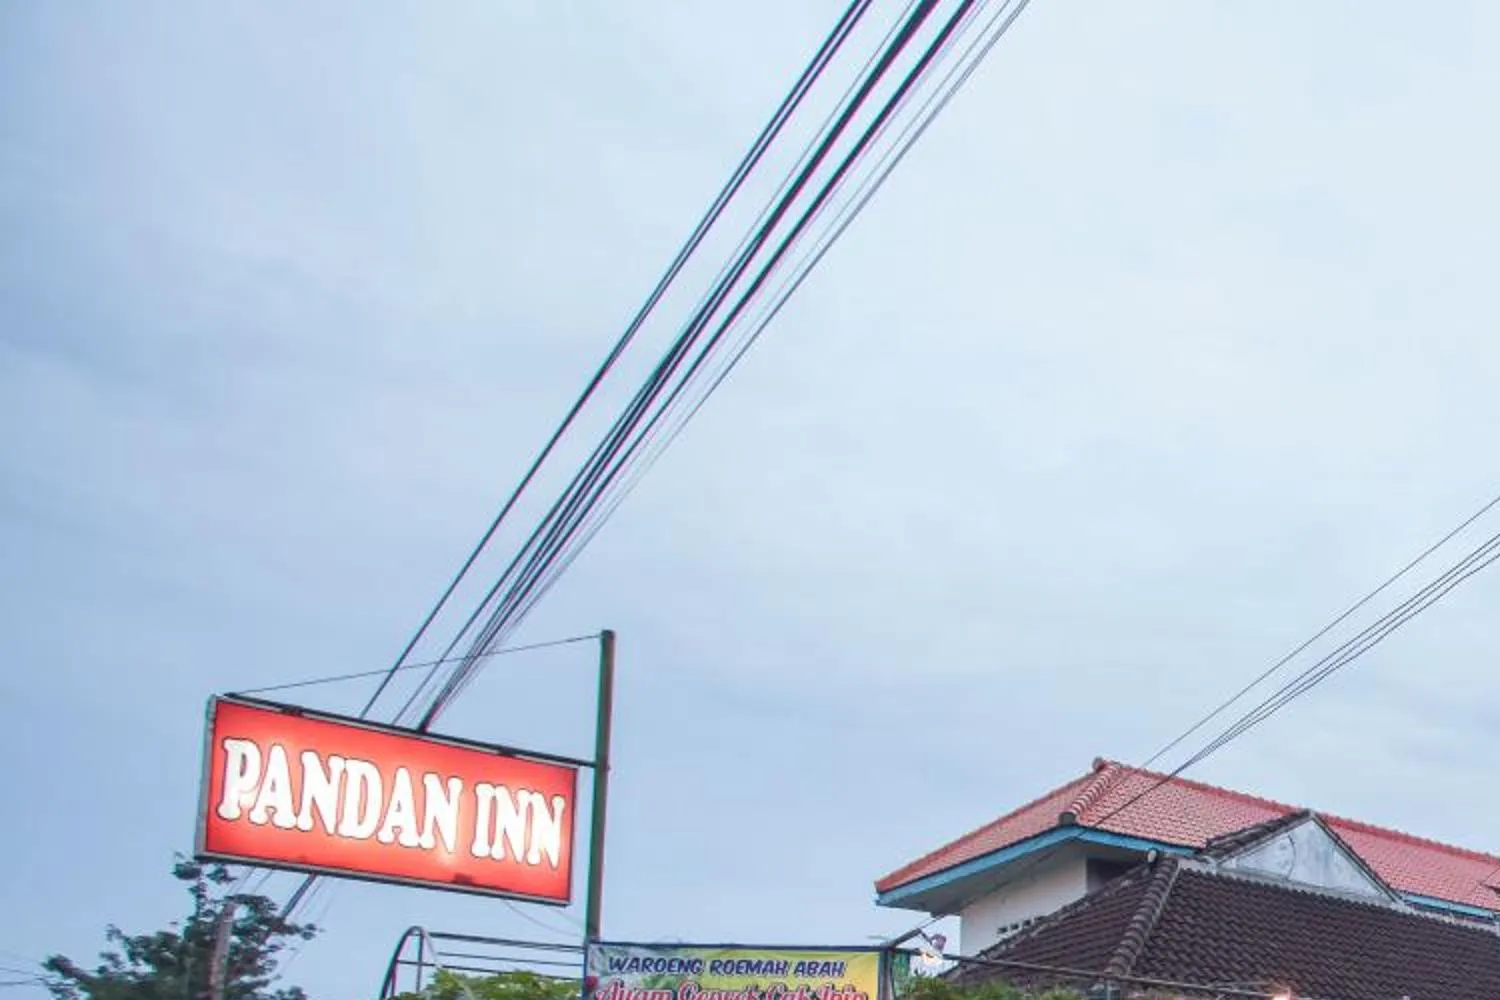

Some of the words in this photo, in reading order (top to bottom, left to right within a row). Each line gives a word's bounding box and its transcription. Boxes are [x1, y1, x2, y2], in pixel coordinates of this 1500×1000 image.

[216, 737, 465, 854] PANDAN
[470, 782, 565, 869] INN
[608, 956, 704, 975] WAROENG
[709, 958, 789, 976] ROEMAH
[794, 959, 846, 977] ABAH
